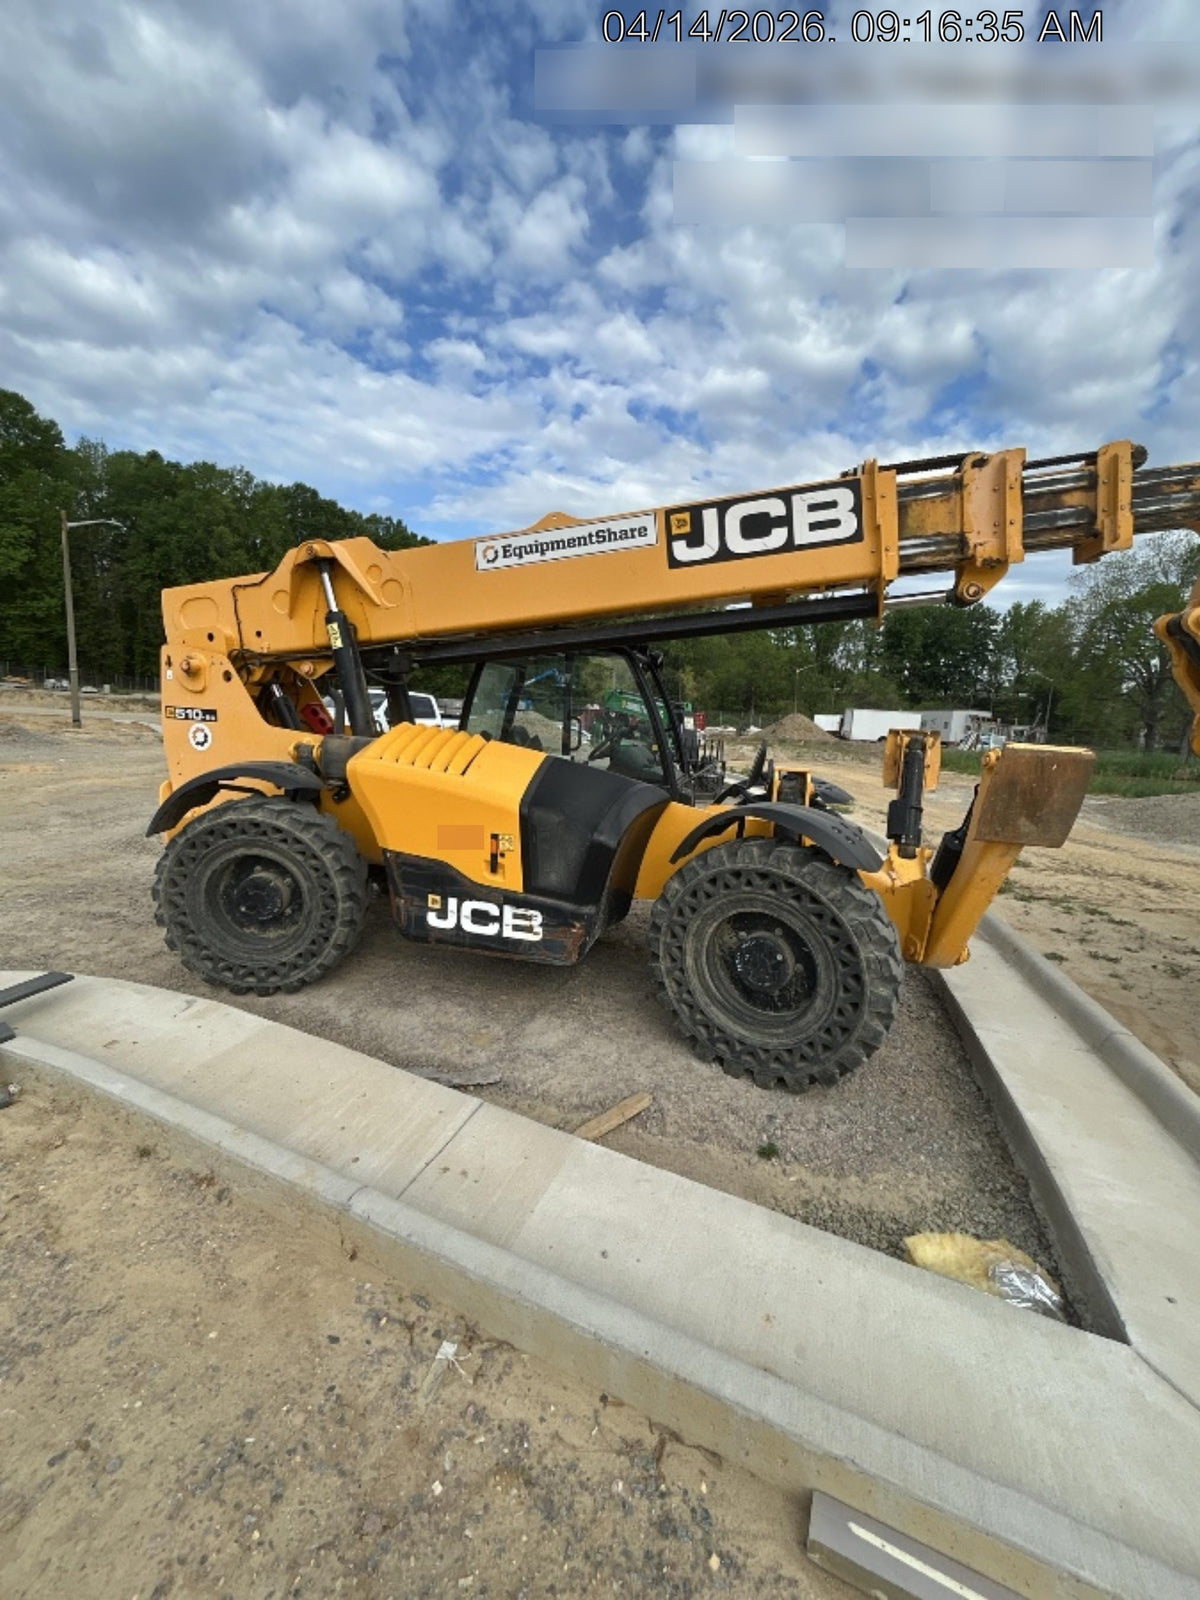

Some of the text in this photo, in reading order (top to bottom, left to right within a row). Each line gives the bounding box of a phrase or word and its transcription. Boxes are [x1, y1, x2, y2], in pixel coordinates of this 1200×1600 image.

[501, 525, 648, 560] EquipmentShare
[671, 487, 858, 562] JCB
[426, 897, 543, 941] JCB
